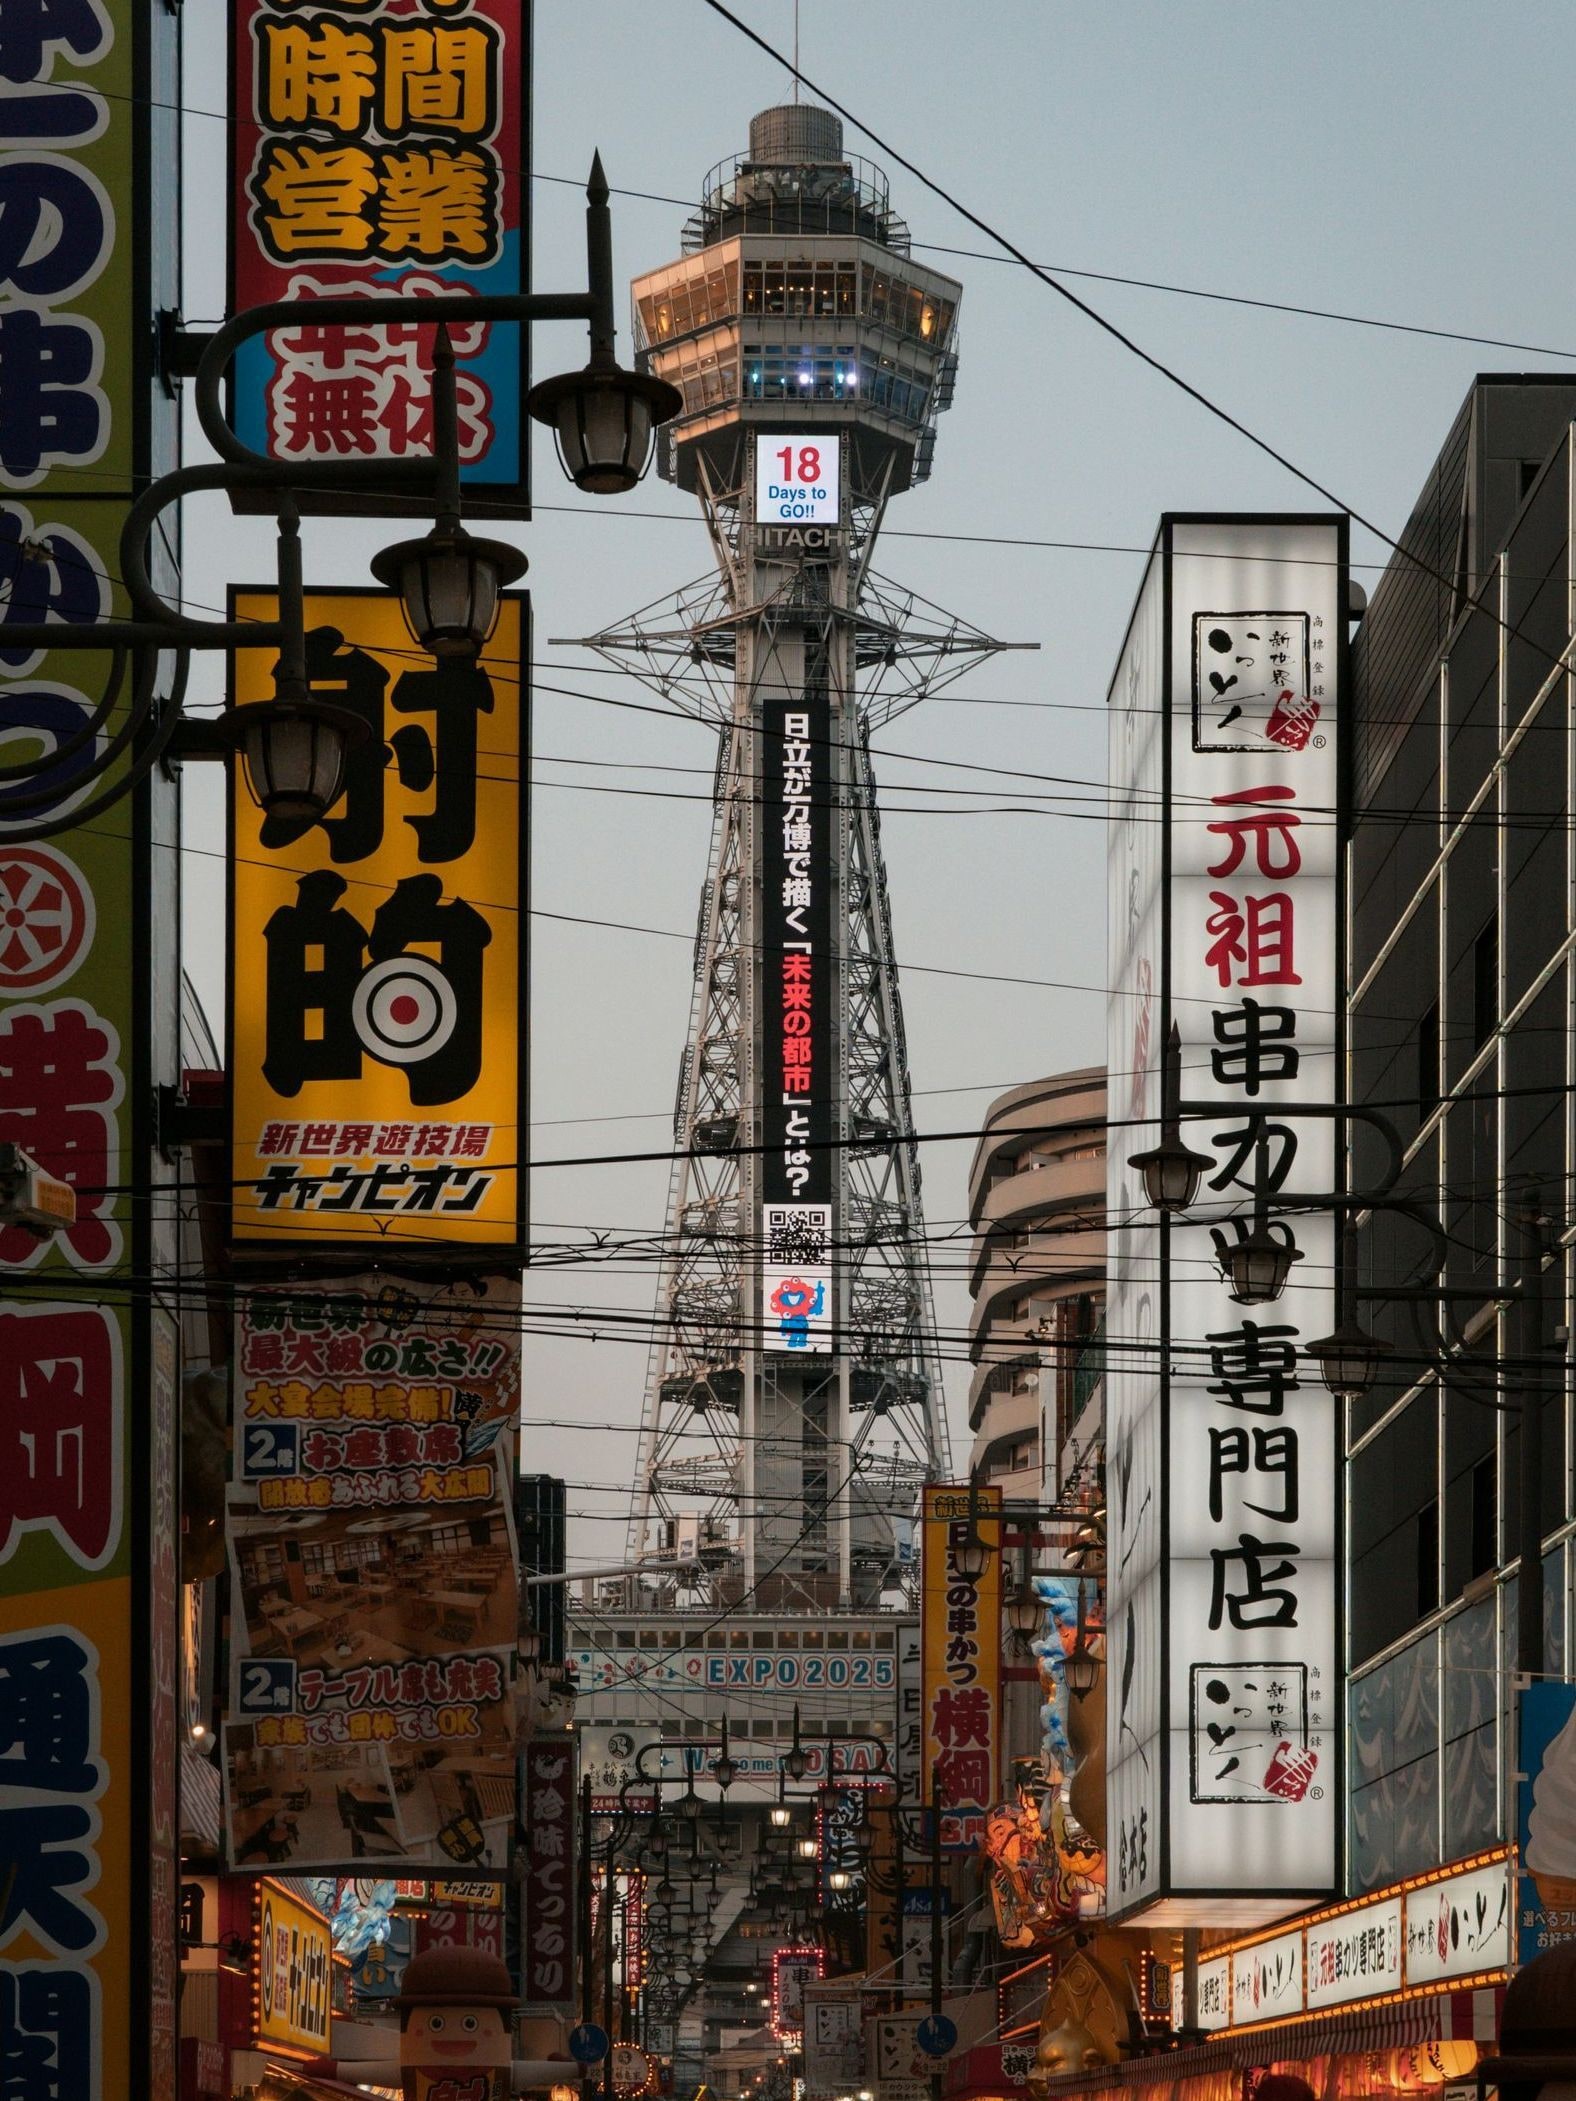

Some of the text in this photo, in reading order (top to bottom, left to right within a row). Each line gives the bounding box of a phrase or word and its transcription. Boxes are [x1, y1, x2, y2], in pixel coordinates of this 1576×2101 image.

[264, 21, 489, 135] 時間
[262, 145, 489, 254] 営業
[777, 446, 821, 483] 18
[768, 485, 827, 502] Days to
[780, 504, 814, 518] GO!!
[743, 528, 850, 548] HITACHI
[262, 625, 495, 1109] 射的
[258, 1123, 491, 1158] 新世界遊技場
[255, 1163, 494, 1211] チャンピオン
[245, 1380, 455, 1422] 大宴会場完備!
[303, 1425, 462, 1471] お座敷席
[945, 1520, 978, 1686] 日一の串かつ
[299, 1659, 501, 1710] テーブル席も充実
[255, 1704, 480, 1746] 家族でも団体でもOK
[683, 1747, 773, 1776] Weome
[807, 1747, 895, 1775] OSAK
[932, 1687, 992, 1808] 横綱
[903, 1896, 946, 1912] Asai
[1319, 1923, 1385, 1988] 元祖串カツ専門店
